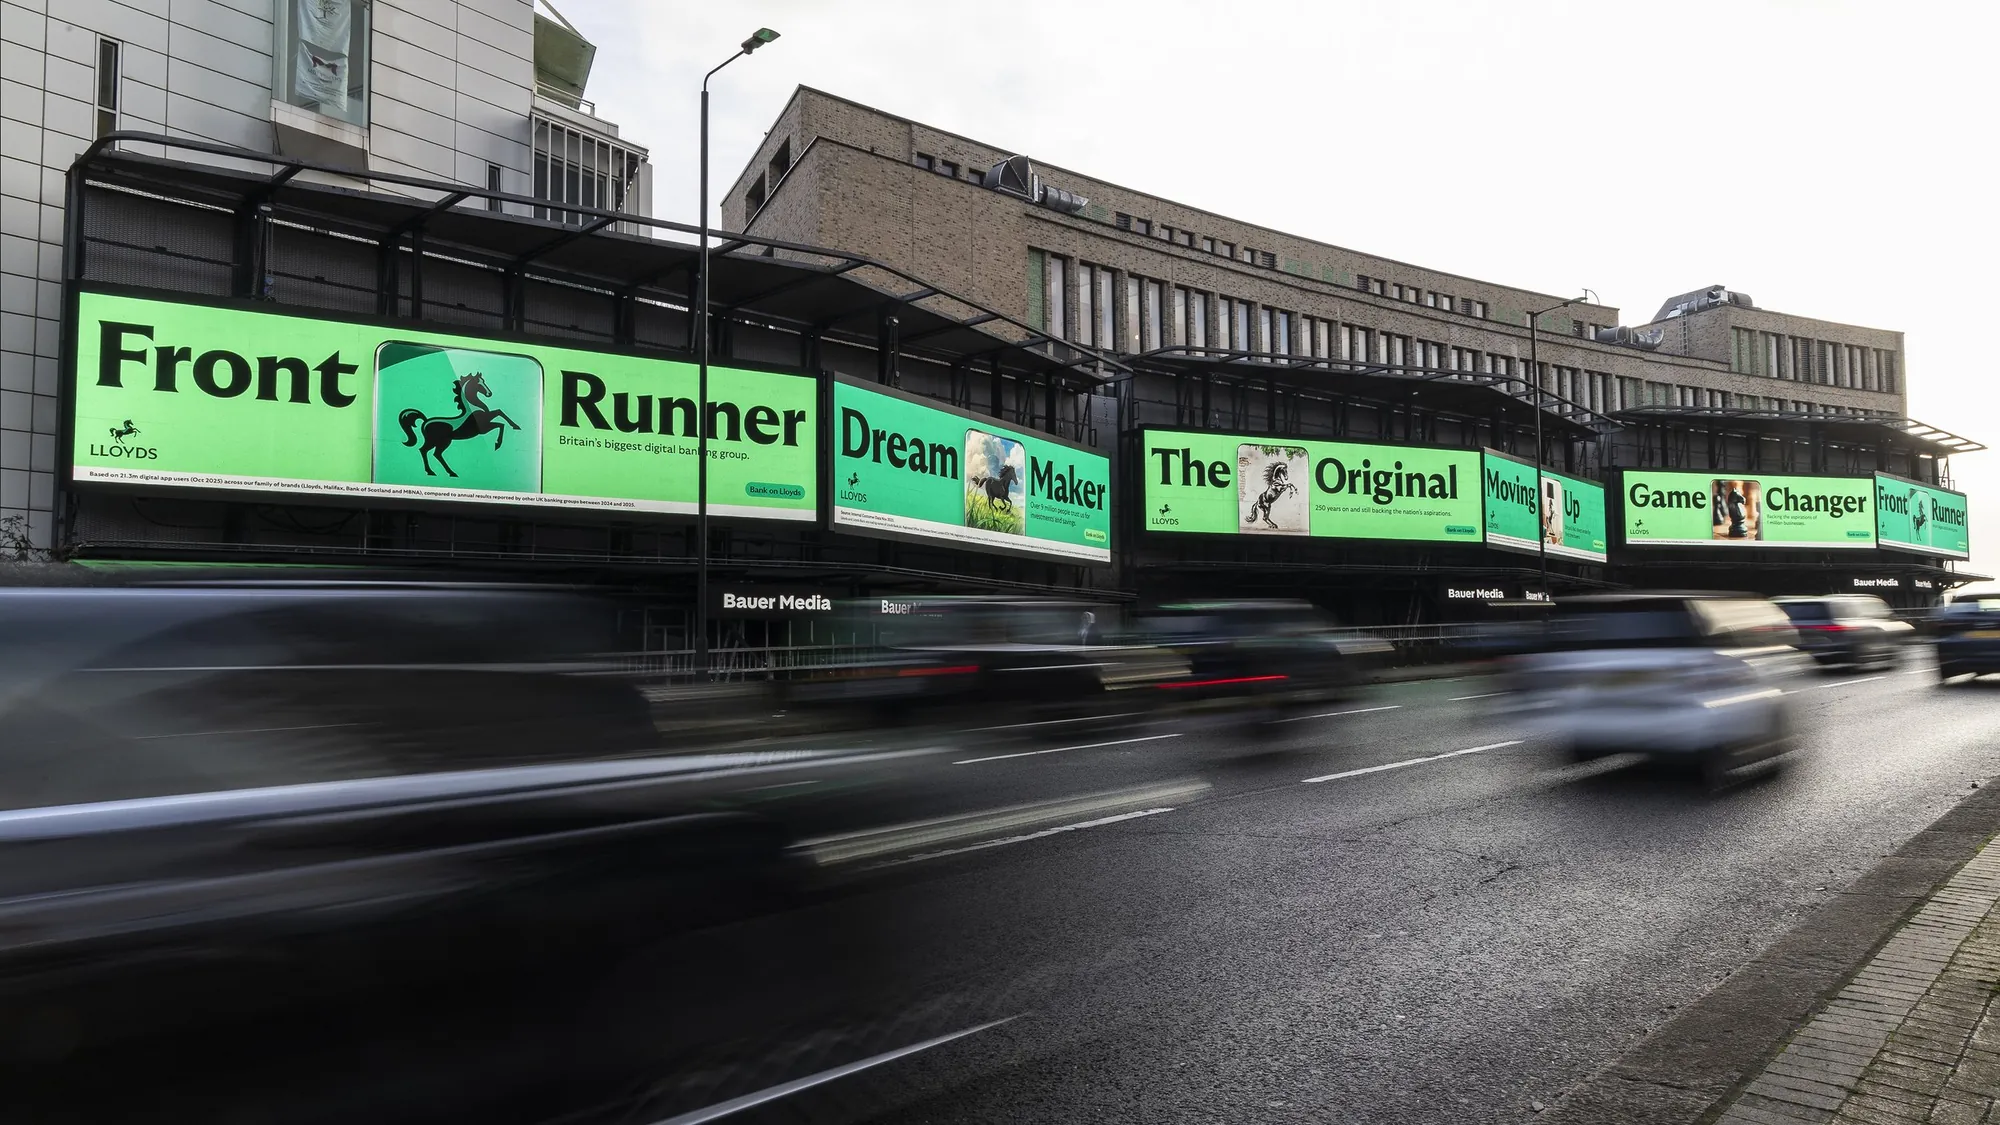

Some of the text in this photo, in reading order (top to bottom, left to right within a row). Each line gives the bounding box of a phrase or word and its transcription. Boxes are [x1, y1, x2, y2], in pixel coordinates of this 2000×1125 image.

[96, 319, 806, 447] Front Runner
[90, 443, 158, 460] LLOYDS
[559, 435, 602, 448] Britain's
[604, 439, 642, 452] biggest
[644, 442, 676, 455] digital
[720, 450, 750, 461] group.
[841, 406, 1106, 511] Dream Maker
[89, 470, 109, 478] Based
[190, 476, 204, 484] (Oct
[205, 477, 223, 485] 2025)
[424, 490, 450, 498] compared
[1151, 447, 1231, 488] The
[1315, 457, 1459, 505] Original
[749, 485, 802, 497] Bank on Lloyds
[840, 489, 867, 503] LLOYDS
[1487, 468, 1580, 524] Moving Up
[1629, 483, 1867, 518] Game Changer
[1878, 485, 1965, 527] Front Runner
[1372, 507, 1392, 515] backing
[1423, 509, 1452, 517] aspirations.
[1151, 517, 1179, 526] LLOYDS
[1853, 578, 1899, 587] Bauer Media
[723, 593, 831, 611] Bauer Media
[1448, 588, 1504, 599] Bauer Media
[881, 599, 911, 615] Bauer
